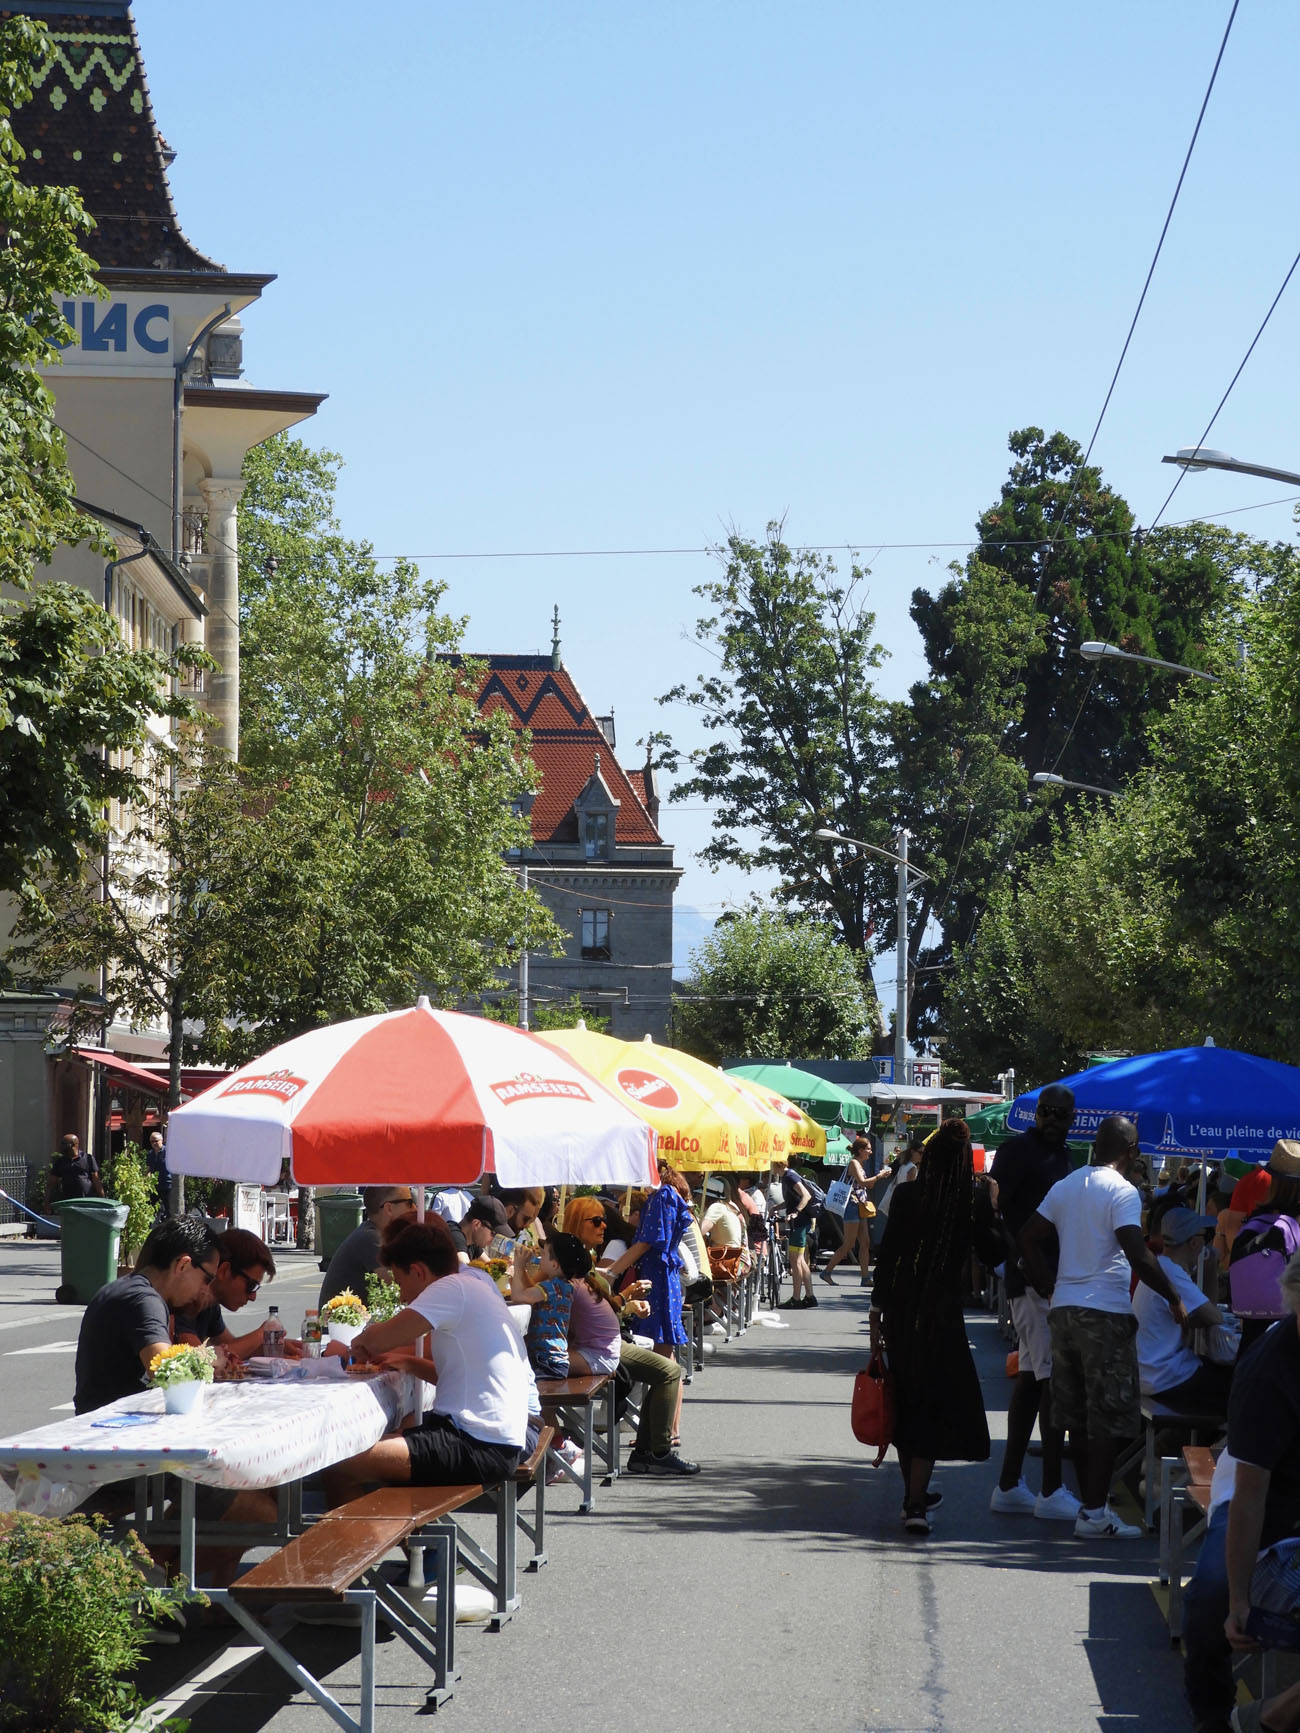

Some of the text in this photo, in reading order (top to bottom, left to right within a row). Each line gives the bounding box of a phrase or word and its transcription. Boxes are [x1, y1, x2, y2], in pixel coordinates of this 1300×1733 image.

[228, 1080, 299, 1096] RAMSEIER
[495, 1083, 586, 1100] RAMSEIER
[1074, 1115, 1104, 1127] HEN
[1190, 1125, 1222, 1136] L'eau
[1226, 1125, 1264, 1139] pleine
[1267, 1127, 1283, 1138] de
[657, 1130, 699, 1152] nalco
[790, 1132, 815, 1149] Sinalco
